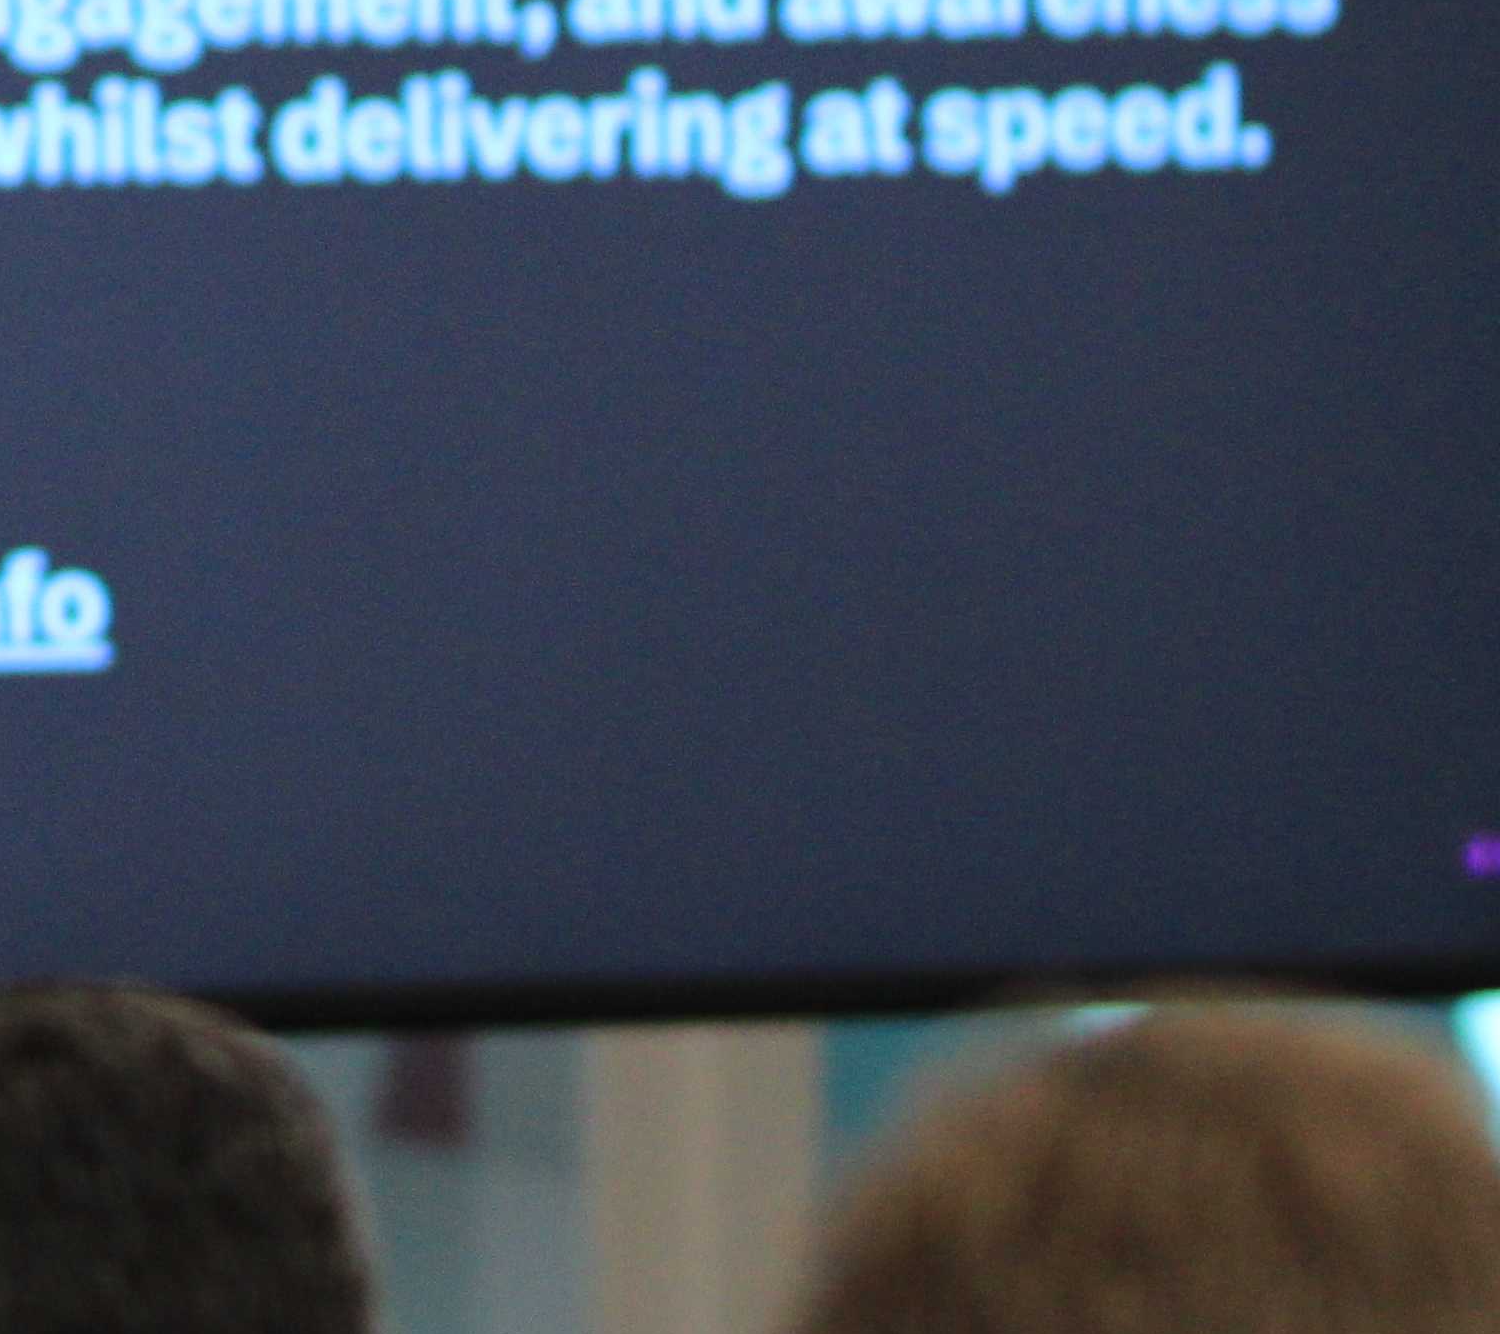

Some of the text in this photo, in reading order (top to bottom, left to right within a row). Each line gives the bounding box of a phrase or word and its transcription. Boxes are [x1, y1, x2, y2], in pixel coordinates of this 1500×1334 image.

[268, 66, 795, 200] delivering
[799, 75, 915, 177] at
[920, 60, 1272, 195] speed.
